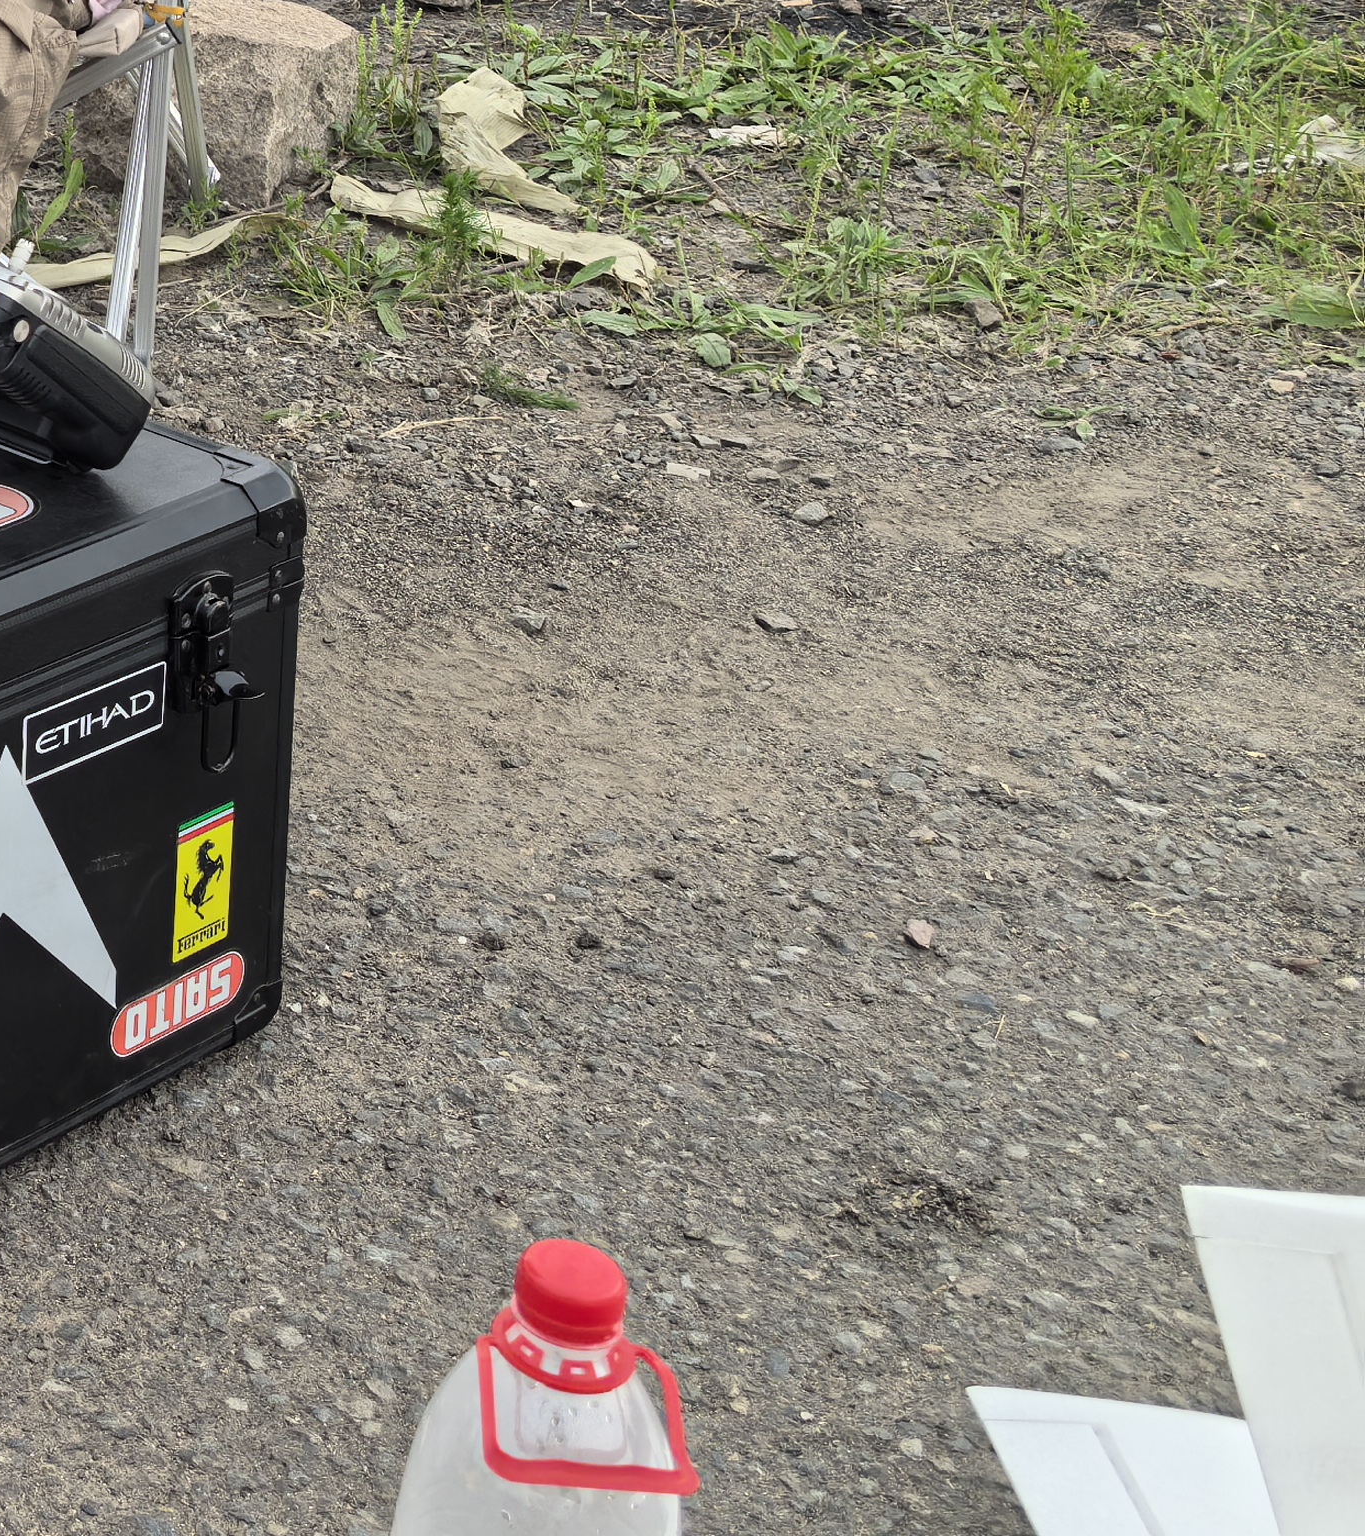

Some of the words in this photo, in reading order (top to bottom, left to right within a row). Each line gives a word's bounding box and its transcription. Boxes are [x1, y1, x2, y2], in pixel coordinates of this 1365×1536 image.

[35, 689, 155, 754] ETIHAD
[176, 917, 226, 955] Ferrari
[124, 957, 233, 1050] SAITO
